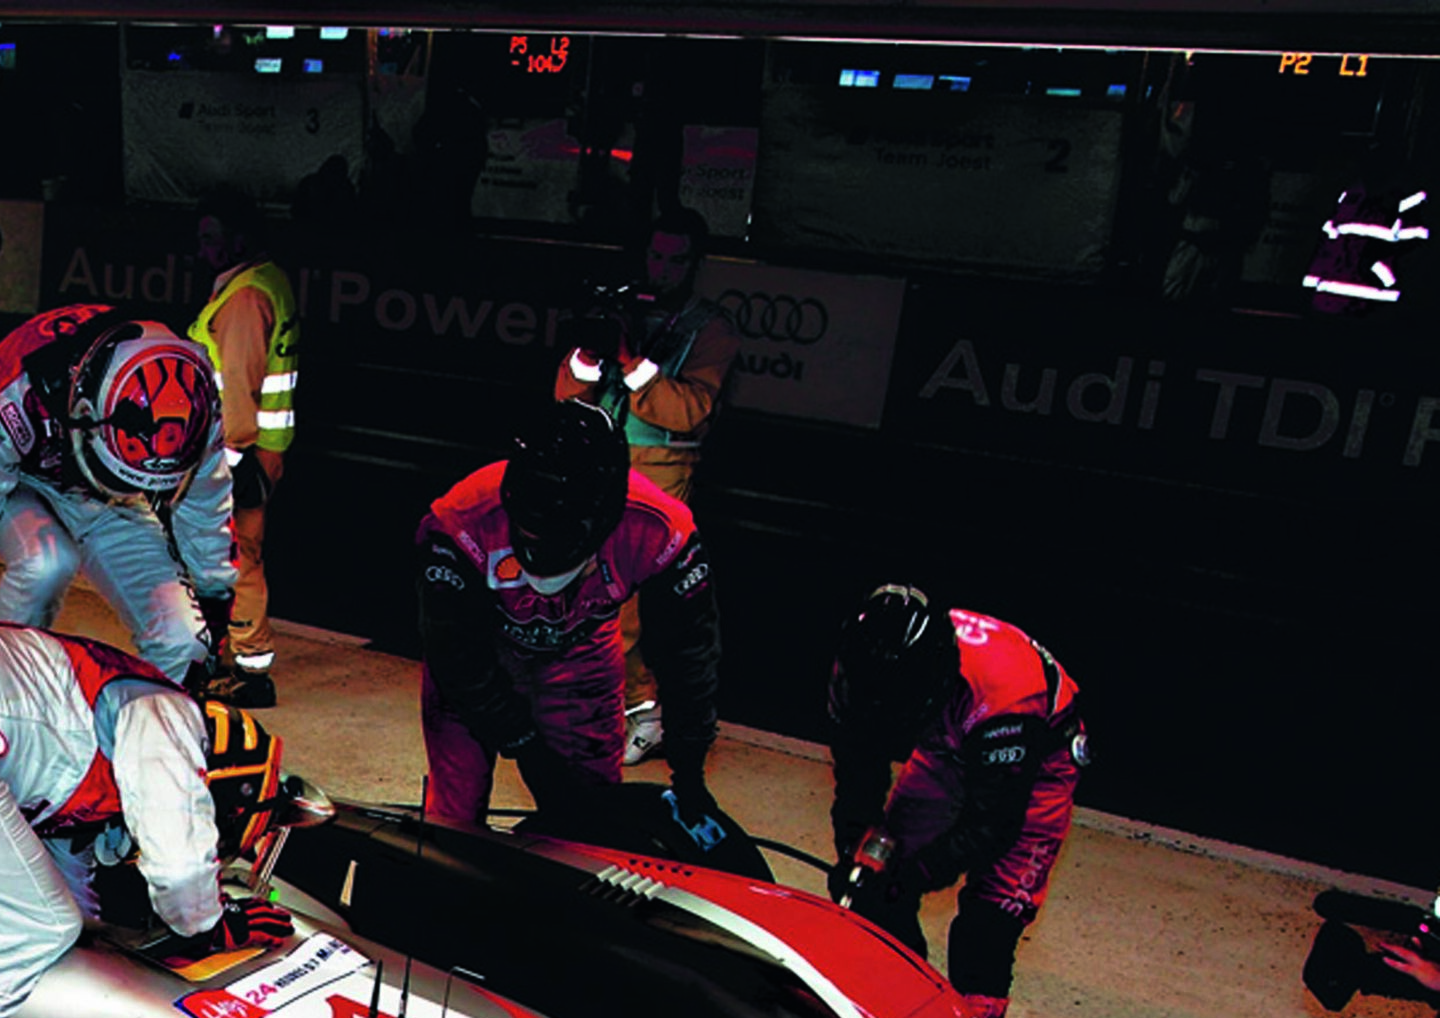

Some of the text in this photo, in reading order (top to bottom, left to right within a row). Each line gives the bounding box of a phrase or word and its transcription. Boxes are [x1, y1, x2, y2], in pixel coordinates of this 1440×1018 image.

[1278, 52, 1369, 77] P2 L1
[306, 107, 320, 134] 3
[1045, 138, 1071, 173] 2
[59, 247, 194, 306] Audi
[329, 270, 572, 348] Power
[918, 338, 1166, 431] Audi
[1195, 369, 1376, 460] TDI
[246, 979, 278, 1006] 24
